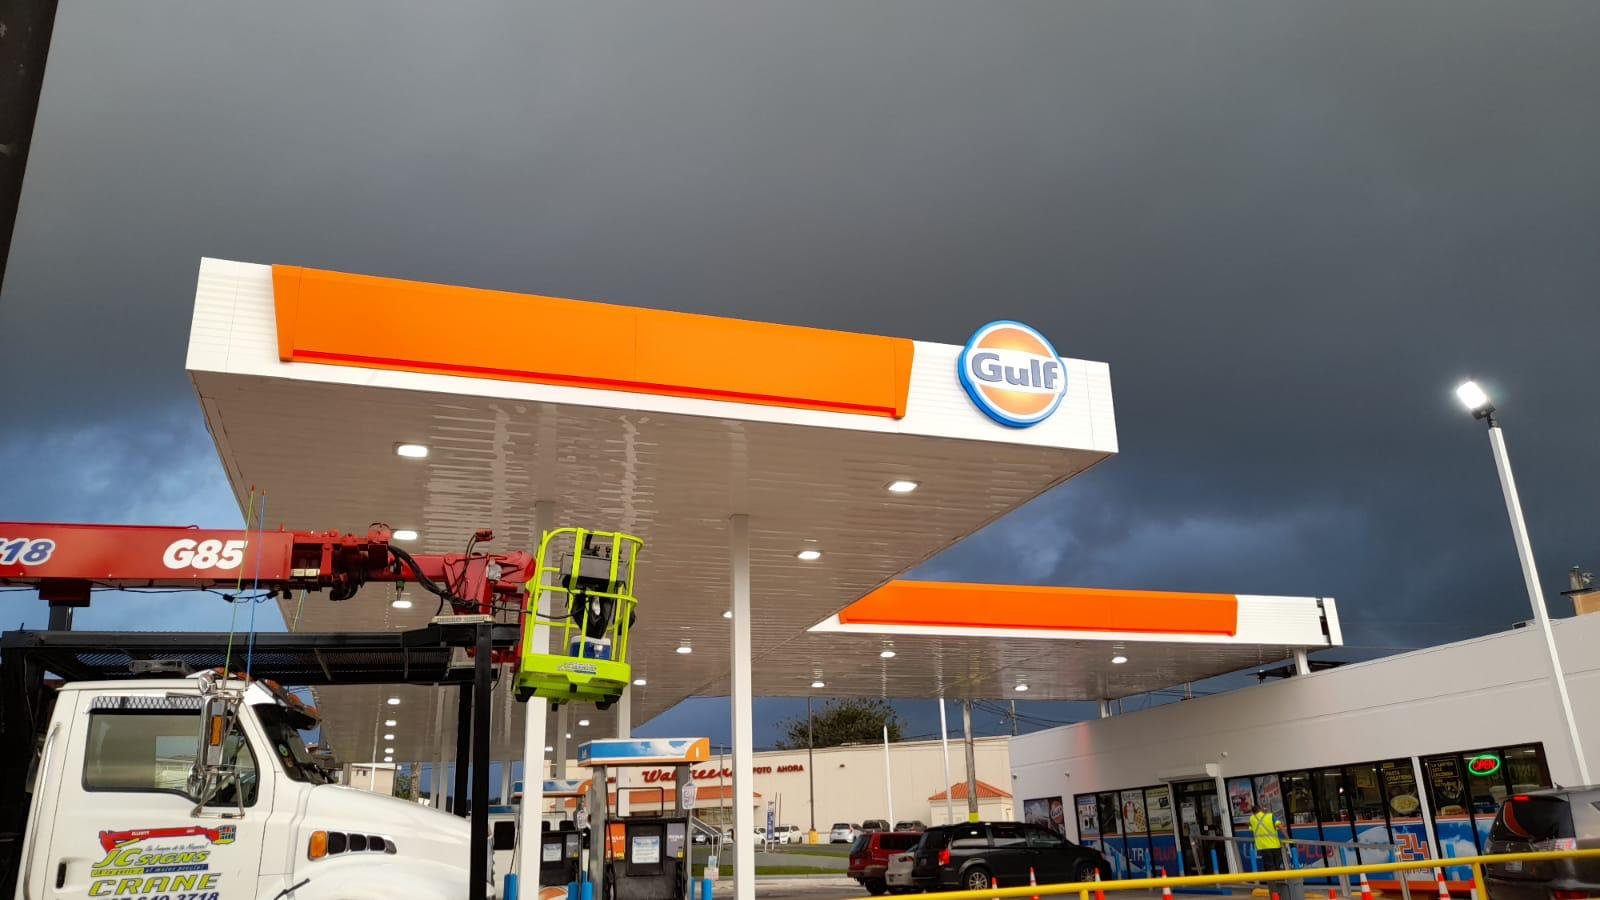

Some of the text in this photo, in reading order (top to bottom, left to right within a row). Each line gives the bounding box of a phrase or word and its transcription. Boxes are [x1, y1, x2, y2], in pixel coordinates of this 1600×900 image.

[972, 353, 1058, 389] Gulf
[162, 539, 248, 569] G85
[642, 768, 733, 783] Walreen
[777, 764, 804, 772] AHORA
[1472, 759, 1496, 770] OPEN
[1395, 833, 1430, 861] 24
[88, 872, 221, 896] CRANE
